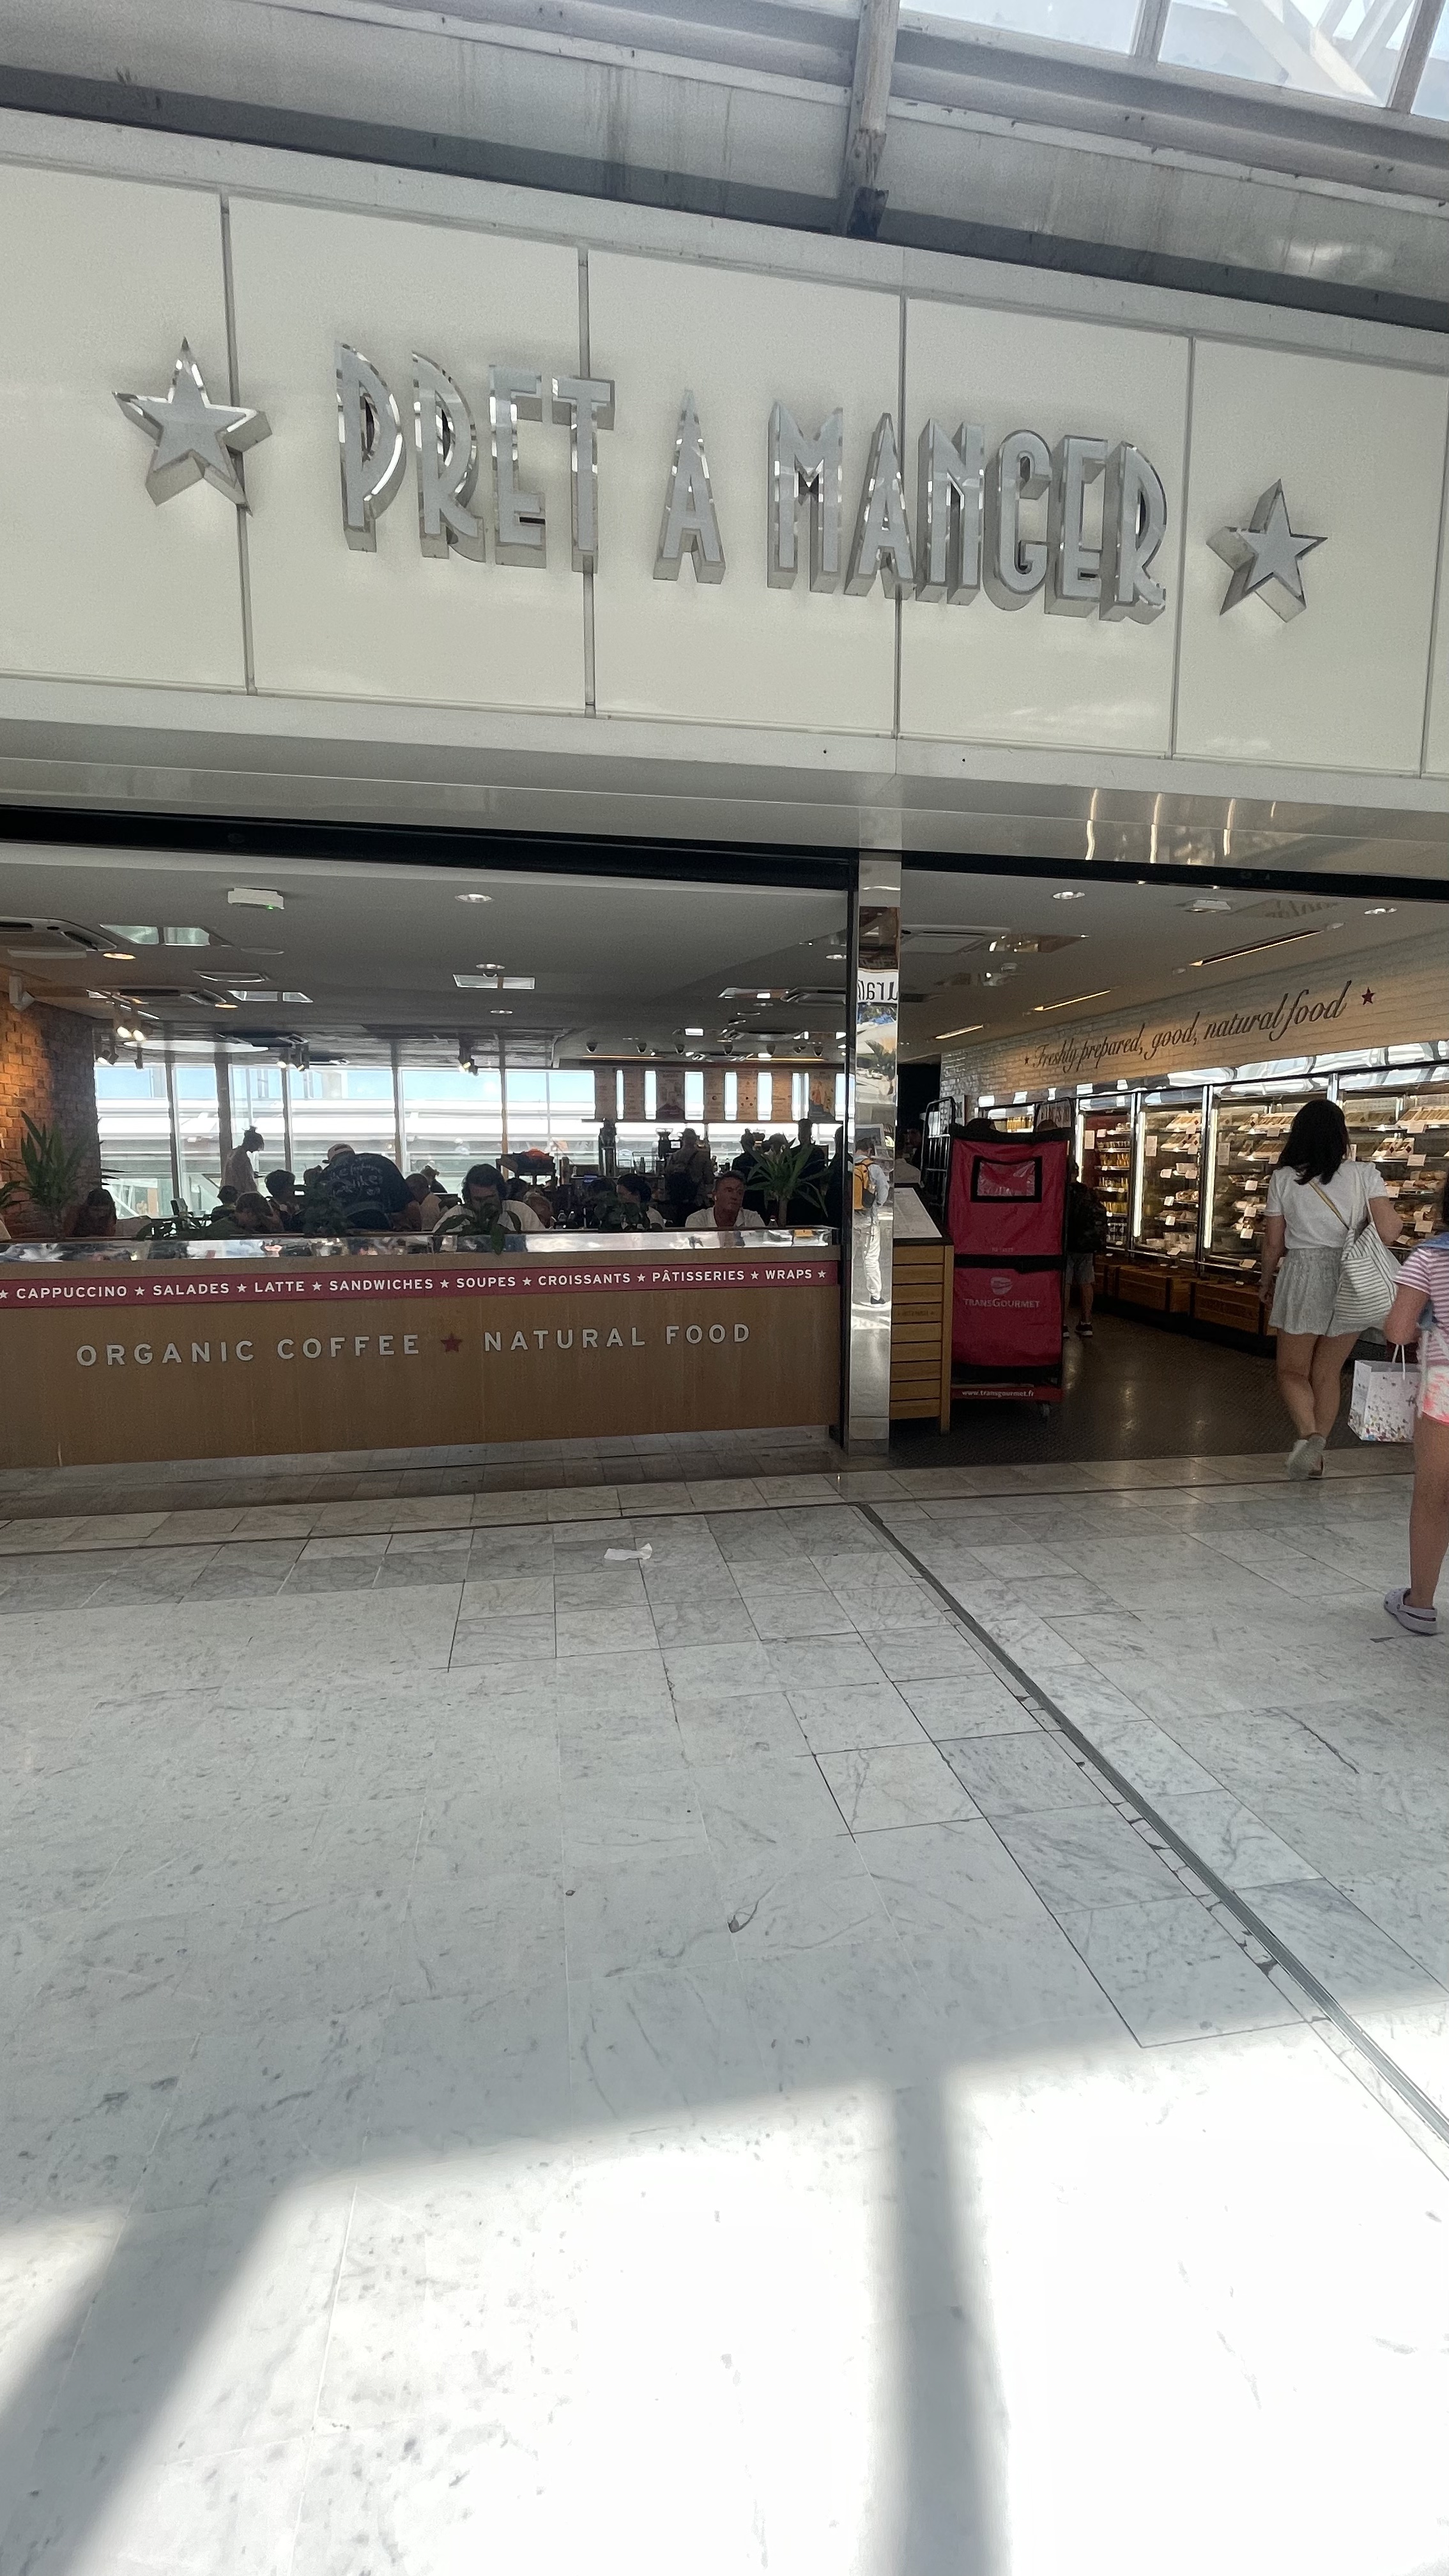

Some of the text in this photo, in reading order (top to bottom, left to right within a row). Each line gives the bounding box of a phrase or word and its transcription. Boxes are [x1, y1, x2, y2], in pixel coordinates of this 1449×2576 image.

[334, 341, 1167, 625] PRET A MANGER
[1144, 1011, 1198, 1061] good,
[1203, 993, 1289, 1040] natural
[1269, 980, 1353, 1042] food
[16, 1269, 813, 1300] CAPPUCCINO SALADES LATTE SANDWICHES SOUPES CROISSANTS PÂTISSERIES WRAPS
[76, 1323, 750, 1366] ORGANIC COFFEE NATURAL FOOD
